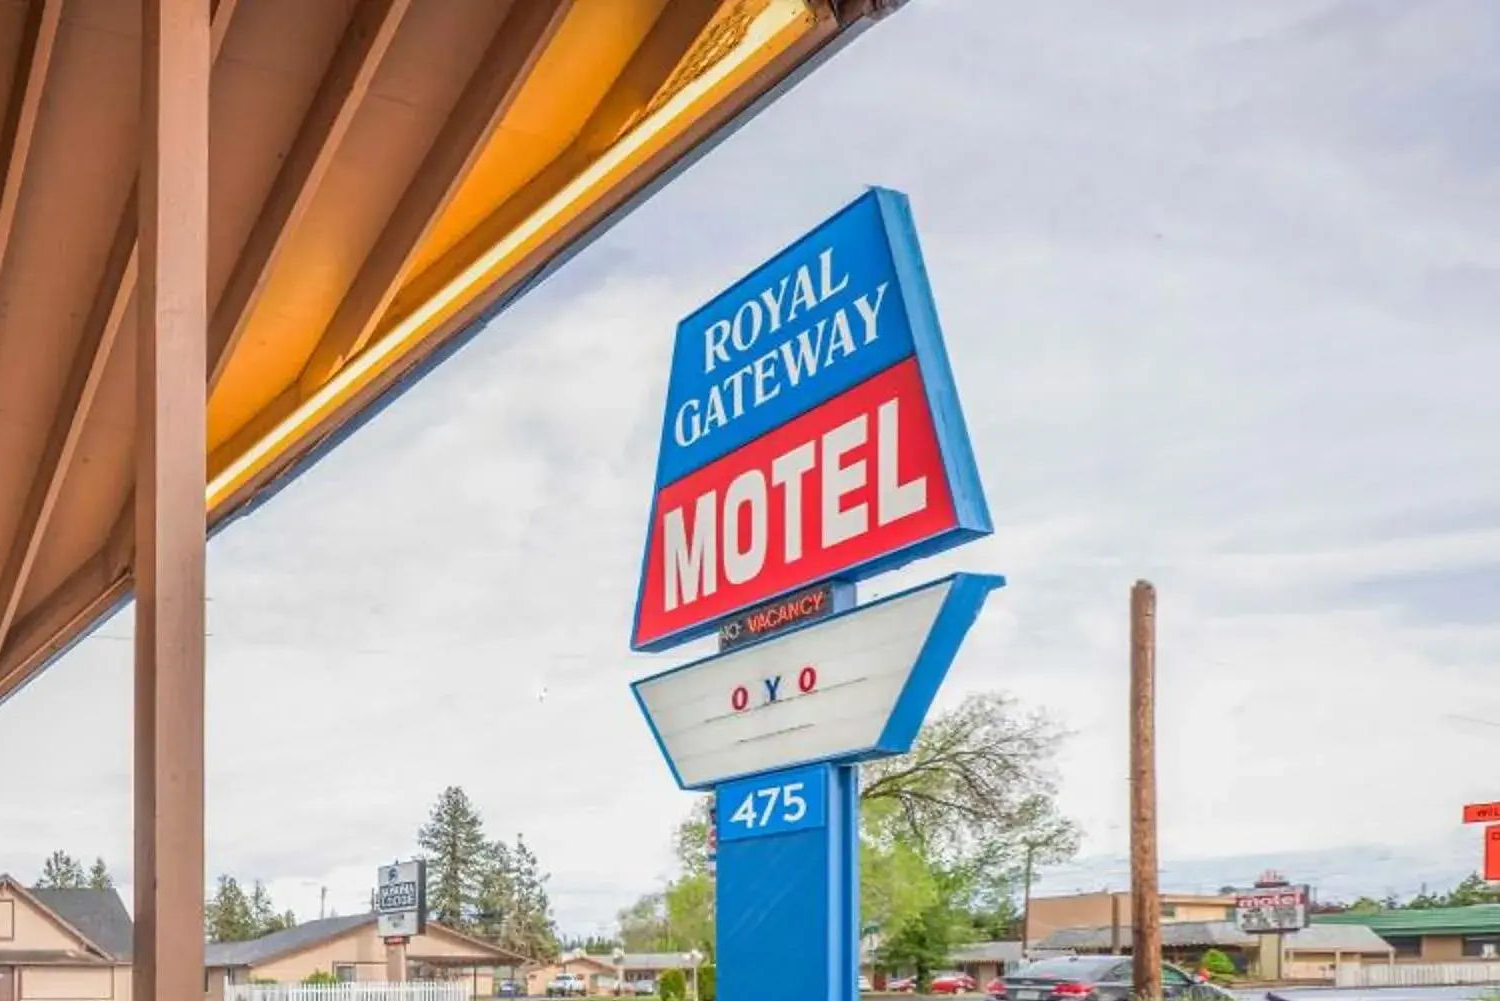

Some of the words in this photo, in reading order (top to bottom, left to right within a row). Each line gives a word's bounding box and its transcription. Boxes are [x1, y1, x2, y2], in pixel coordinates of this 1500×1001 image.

[674, 281, 889, 448] GATEWAY
[703, 247, 850, 374] ROYAL
[663, 396, 927, 613] MOTEL
[747, 591, 823, 633] VACANCY
[729, 782, 808, 830] 475
